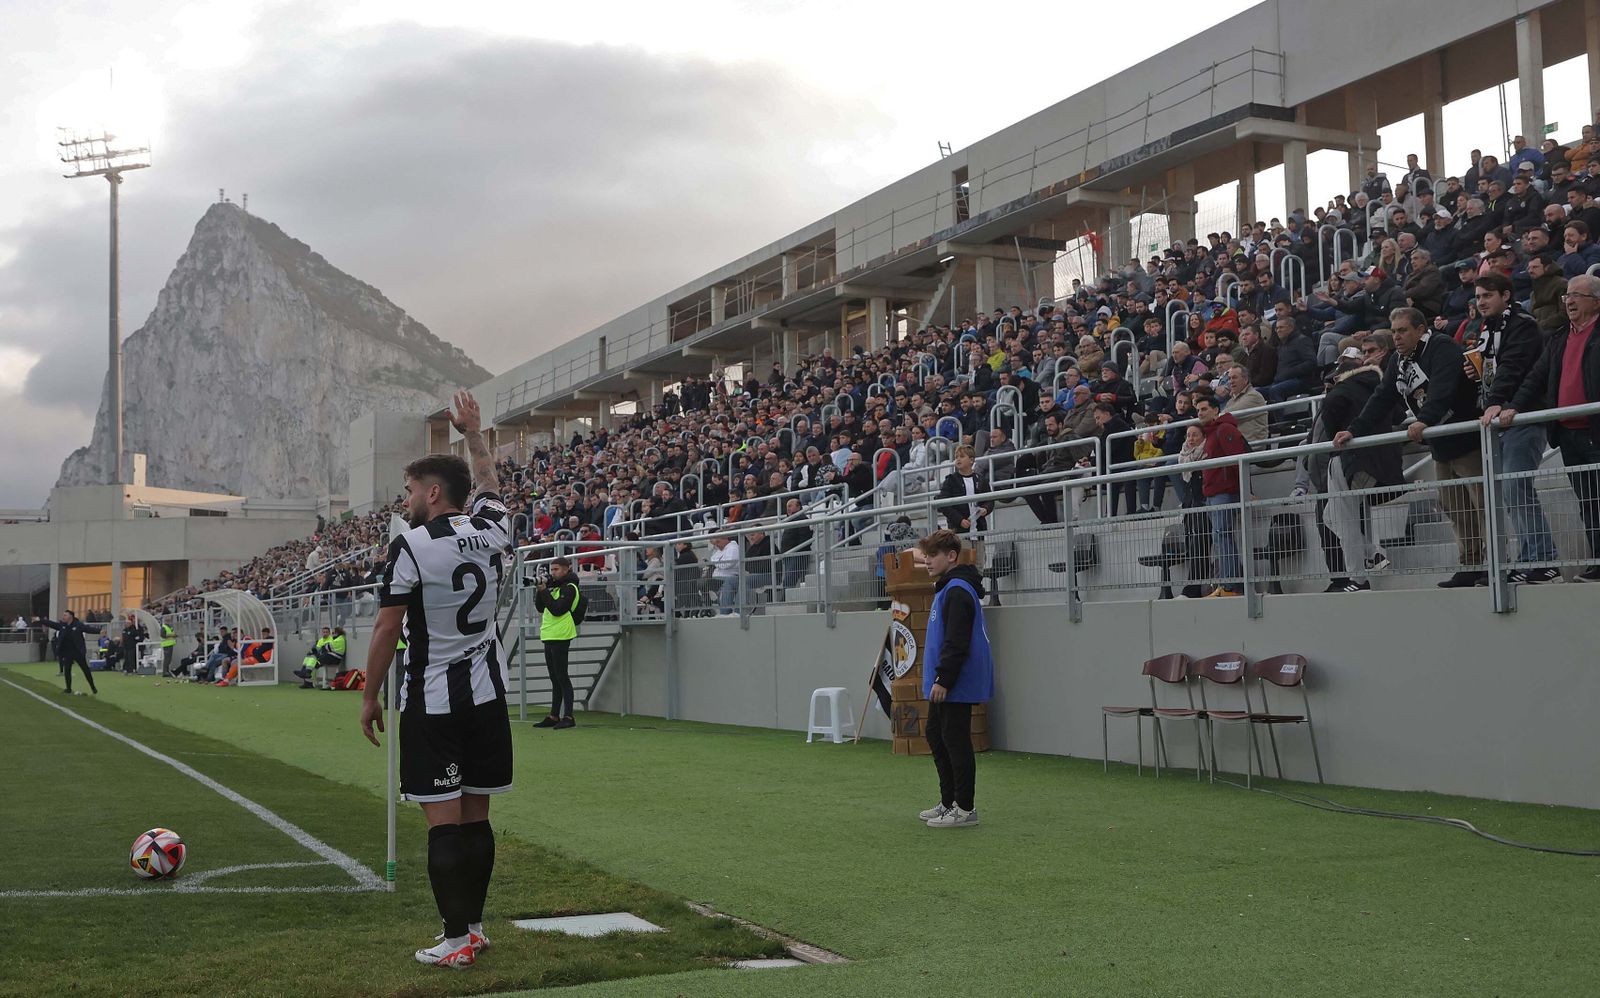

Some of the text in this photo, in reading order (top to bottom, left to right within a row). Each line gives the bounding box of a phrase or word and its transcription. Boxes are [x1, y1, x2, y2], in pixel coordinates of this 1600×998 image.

[456, 535, 490, 554] PITU
[452, 552, 504, 637] 21
[434, 778, 451, 787] Ruiz
